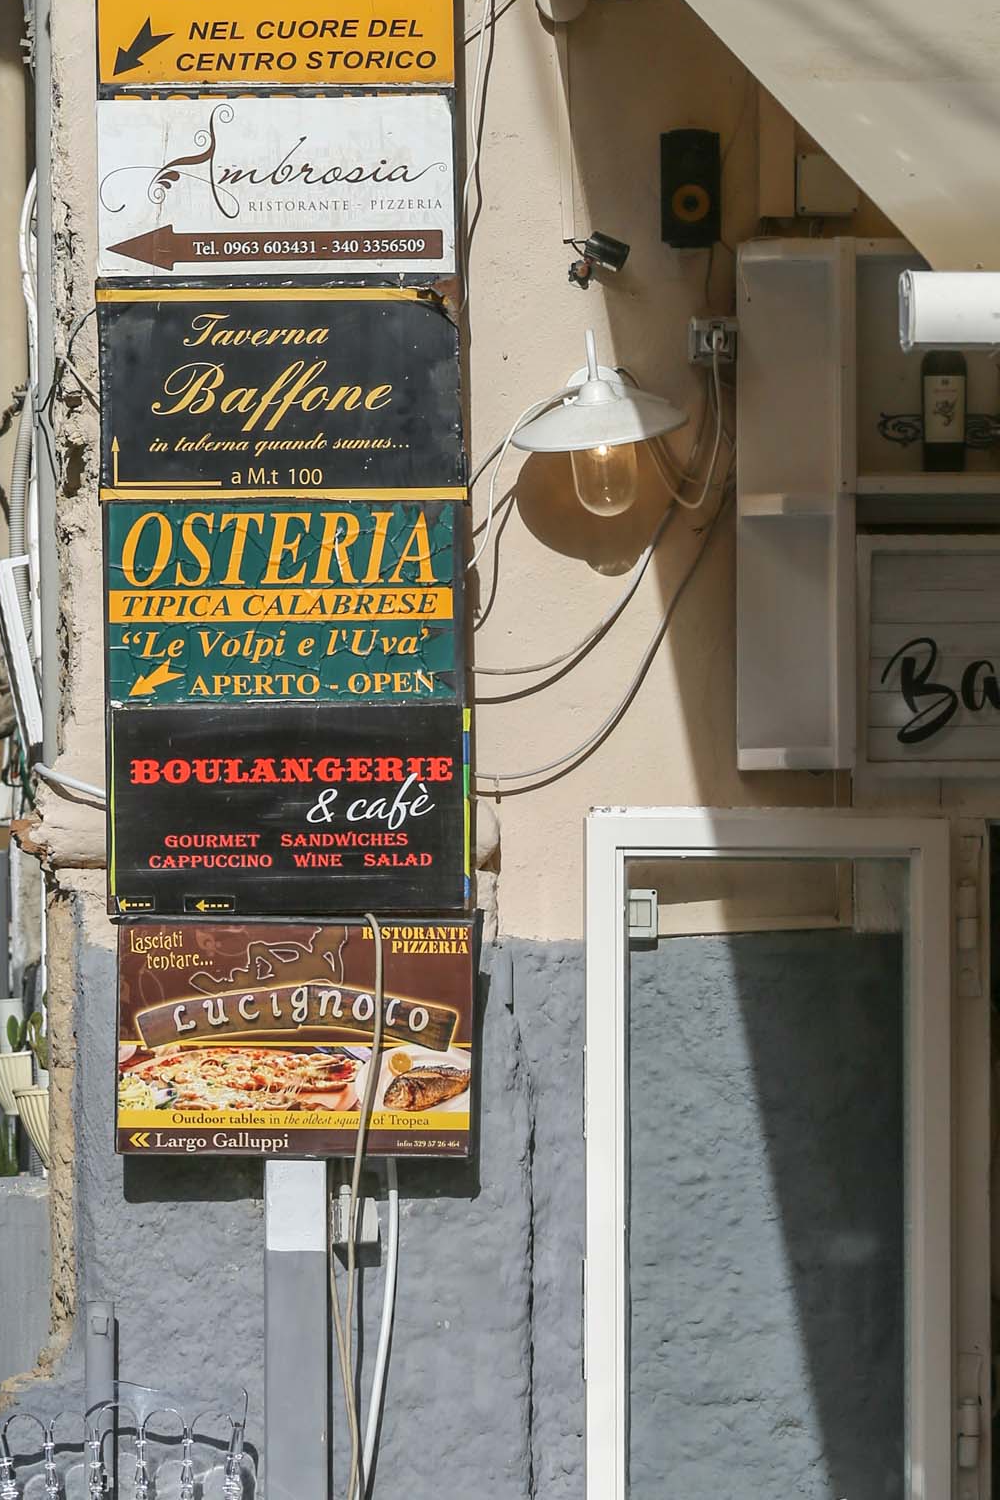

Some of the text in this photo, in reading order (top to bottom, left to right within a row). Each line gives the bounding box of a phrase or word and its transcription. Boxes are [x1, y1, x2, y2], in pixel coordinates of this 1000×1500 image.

[188, 19, 424, 40] NEL CUORE DEL
[176, 50, 437, 72] CENTRO STORICO
[99, 103, 448, 219] Ambrosia
[248, 199, 350, 212] RISTORANTE
[370, 198, 443, 211] PIZZERIA
[192, 241, 220, 256] Tel.
[223, 241, 260, 256] 0963
[263, 240, 316, 255] 603431
[331, 240, 359, 254] 340
[362, 239, 426, 253] 3356509
[182, 313, 330, 347] Taverna
[151, 359, 393, 432] Baffone
[149, 437, 168, 452] in
[174, 432, 249, 452] taberna
[254, 432, 328, 457] quando
[231, 468, 323, 485] a M.t 100
[122, 510, 438, 587] OSTERIA
[123, 592, 438, 617] TIPICA CALABRESE
[199, 629, 287, 664] Volpi
[297, 638, 315, 655] e
[190, 673, 320, 696] APERTO
[348, 671, 435, 695] OPEN
[130, 756, 453, 785] BOULANGERIE
[306, 788, 339, 823] &
[164, 832, 409, 848] GOURMET SANDWICHES
[149, 853, 433, 868] CAPPUCCINO WINE SALAD
[129, 929, 183, 954] Lasciati
[362, 926, 468, 940] RSTORANTE
[391, 940, 469, 954] PIZZERIA
[172, 1112, 429, 1129] Outdoor tables in the oldest squa of Tropea
[155, 1131, 289, 1152] Largo Galluppi
